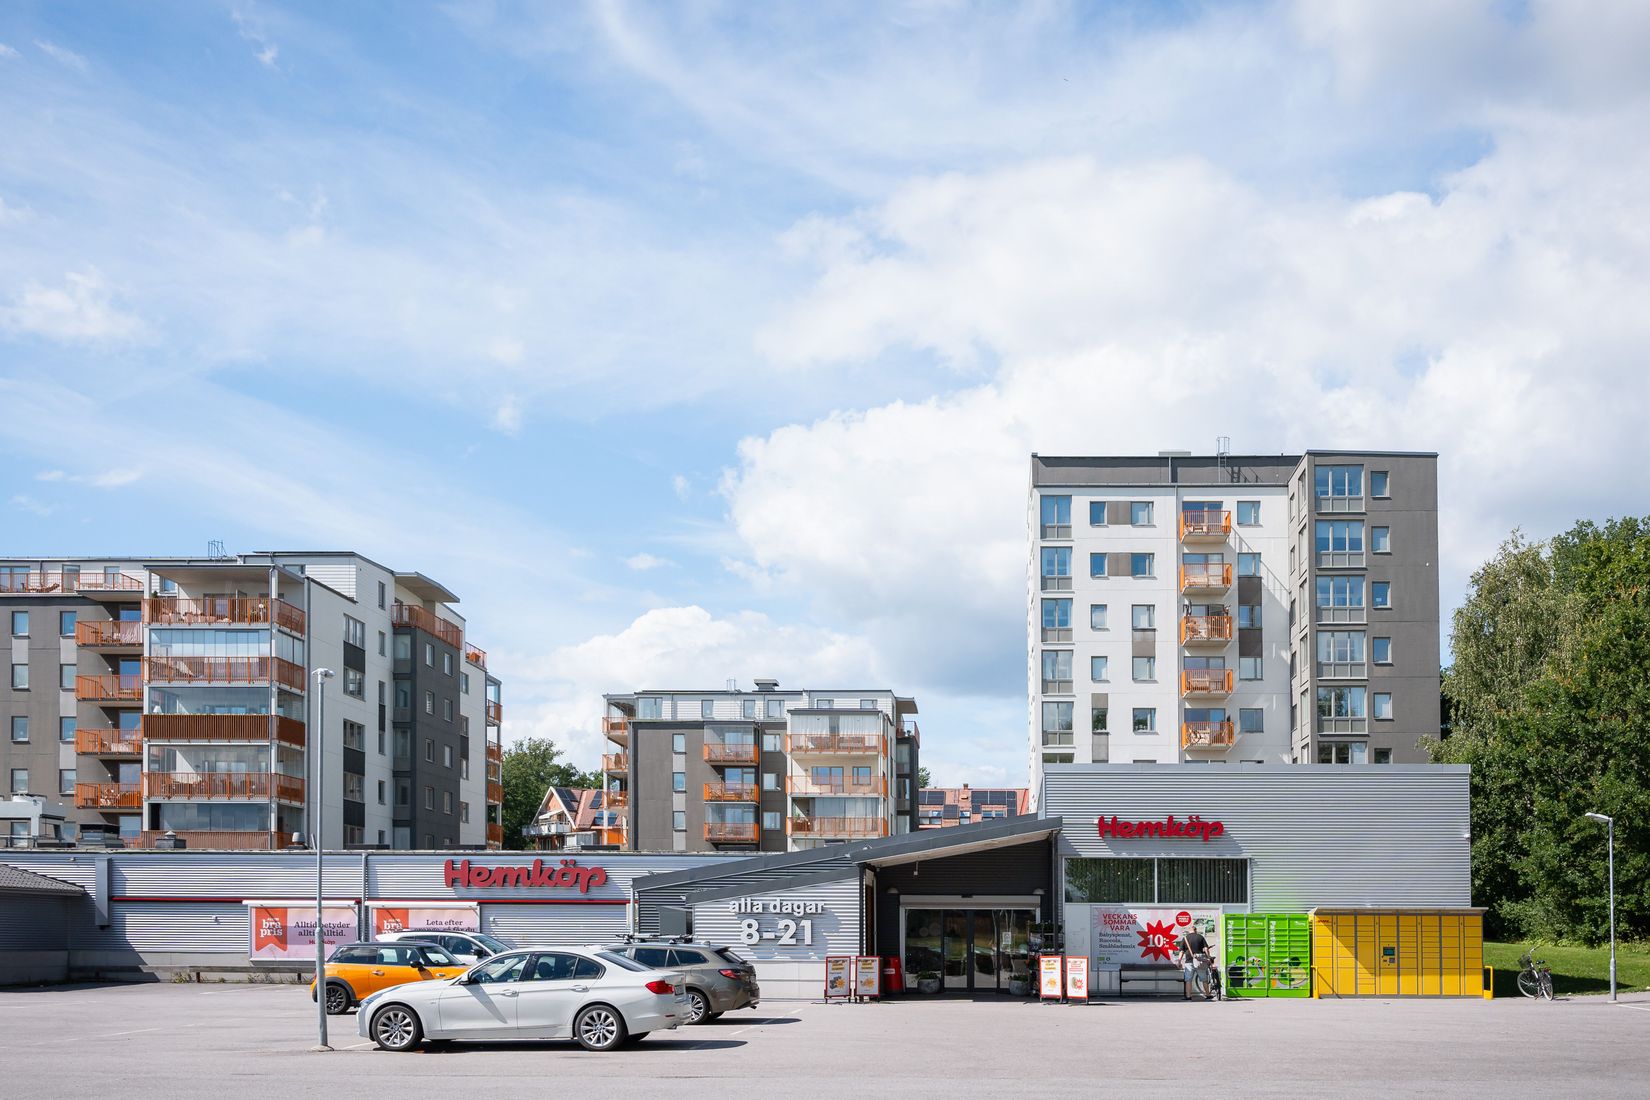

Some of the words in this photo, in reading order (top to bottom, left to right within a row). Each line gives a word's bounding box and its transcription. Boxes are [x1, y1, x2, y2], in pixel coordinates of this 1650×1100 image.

[1097, 815, 1225, 842] Hemköp
[443, 859, 607, 893] Hemköp
[729, 898, 763, 913] alla
[769, 898, 824, 916] dagar
[262, 919, 282, 929] bra
[294, 921, 318, 929] Alltid
[383, 919, 403, 930] bra
[260, 928, 283, 938] pris
[298, 929, 316, 937] allti
[740, 919, 812, 945] 8-21
